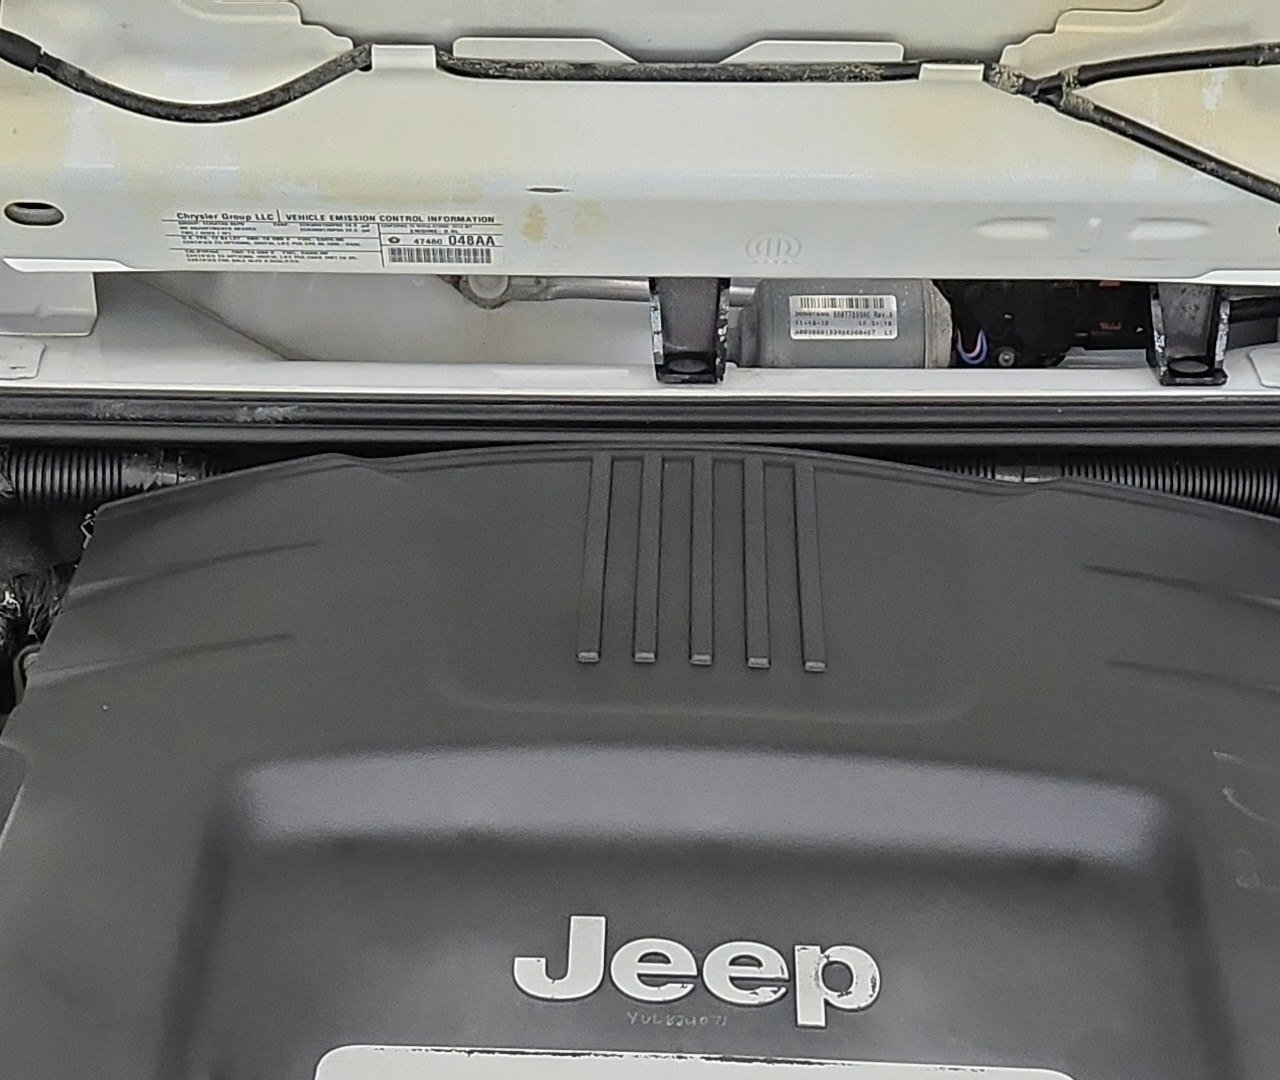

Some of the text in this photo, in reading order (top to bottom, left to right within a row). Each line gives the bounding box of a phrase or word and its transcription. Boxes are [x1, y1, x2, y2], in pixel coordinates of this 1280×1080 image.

[176, 212, 274, 222] Chrysler Group LLC
[285, 214, 495, 223] VEHICLE EMISSION CONTROL INFORMATION
[448, 235, 496, 246] 048AA
[513, 915, 882, 1028] Jeep
